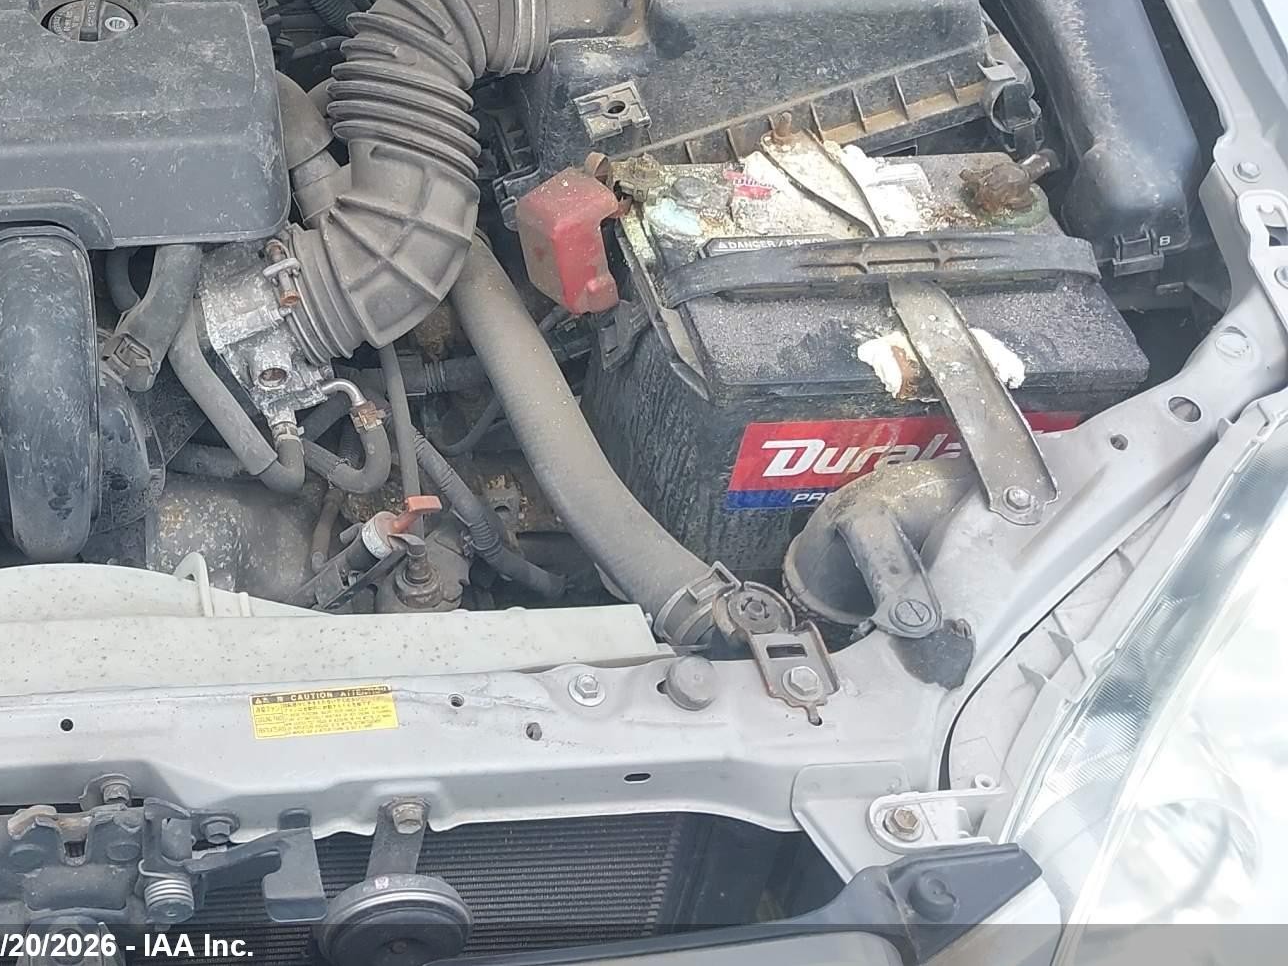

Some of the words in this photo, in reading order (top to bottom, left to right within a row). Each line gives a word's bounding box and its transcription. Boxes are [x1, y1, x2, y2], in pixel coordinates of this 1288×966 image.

[727, 240, 776, 250] DANGER
[761, 433, 963, 477] Dural
[791, 491, 835, 504] PR
[289, 691, 334, 701] CAUTION
